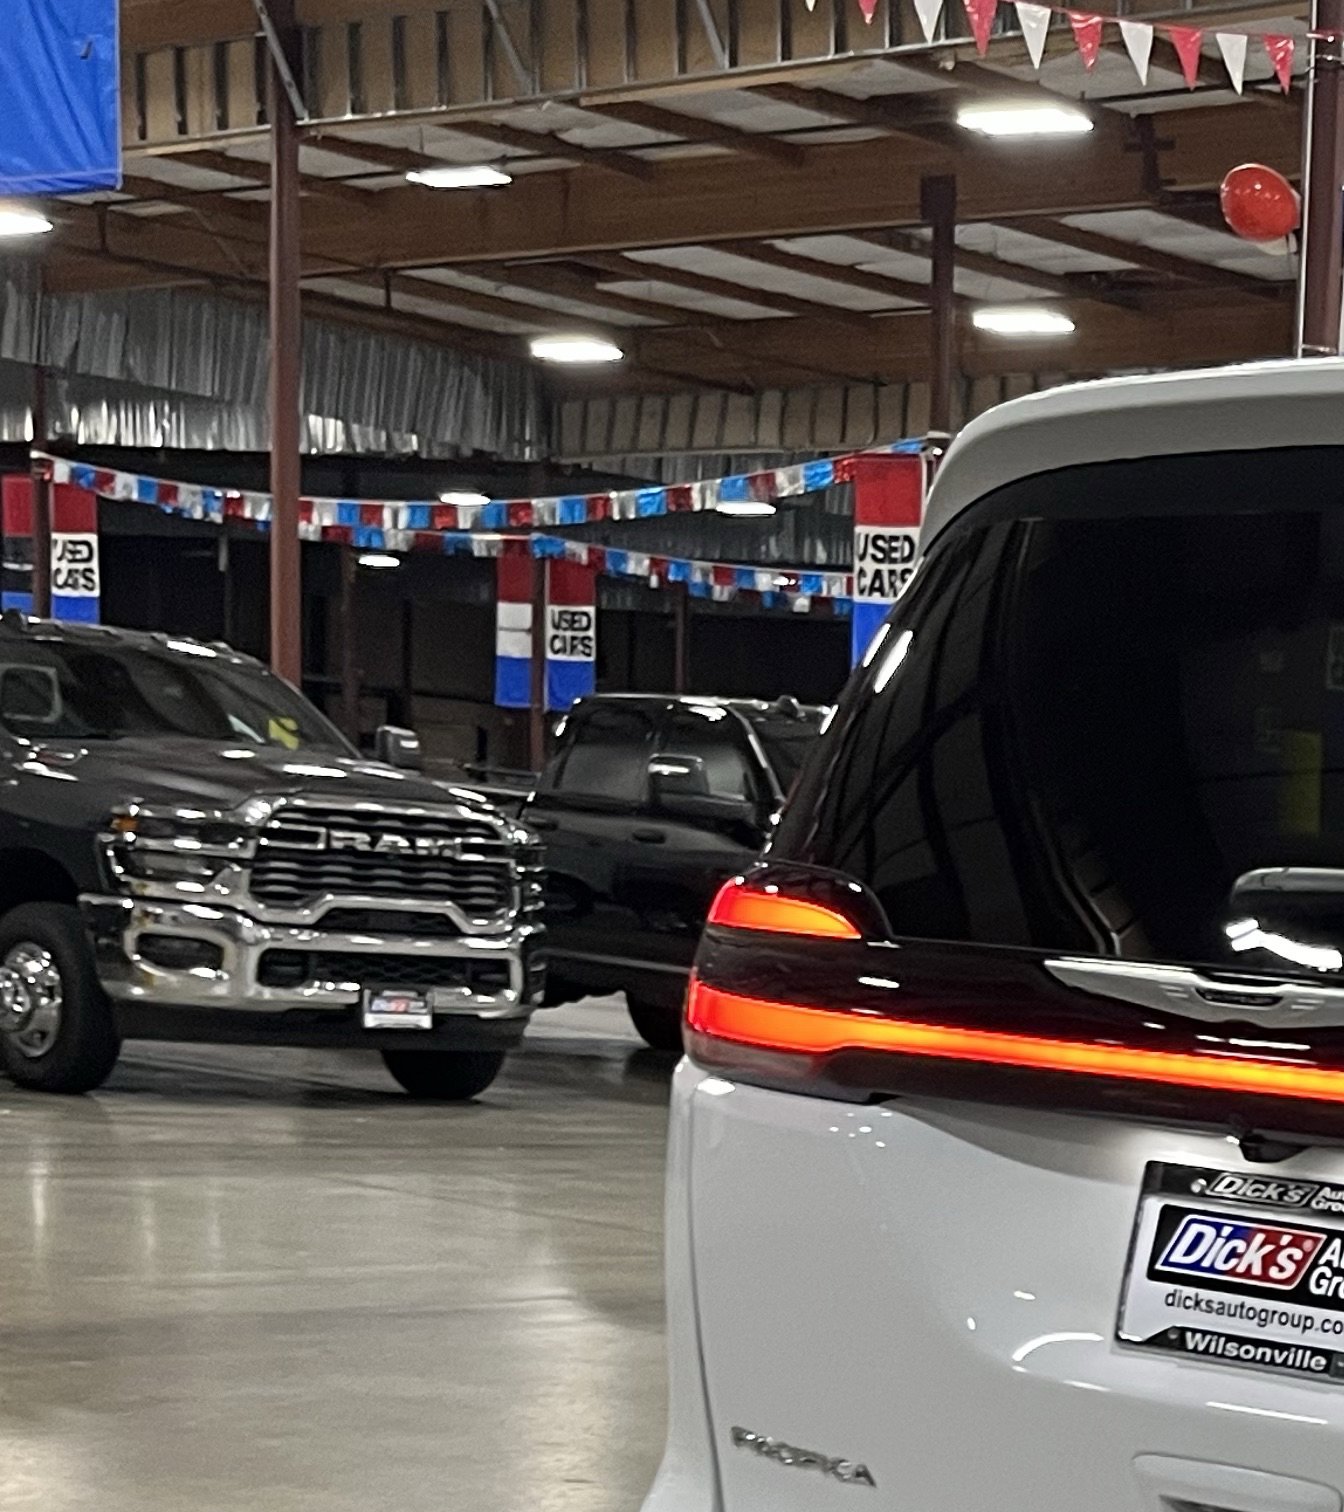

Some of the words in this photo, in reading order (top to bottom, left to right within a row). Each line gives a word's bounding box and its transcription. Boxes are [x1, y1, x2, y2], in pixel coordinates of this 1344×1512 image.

[857, 532, 915, 564] USED
[1214, 1175, 1308, 1203] Dick's
[1169, 1223, 1304, 1281] Dick's
[1185, 1331, 1328, 1372] Wilsonville
